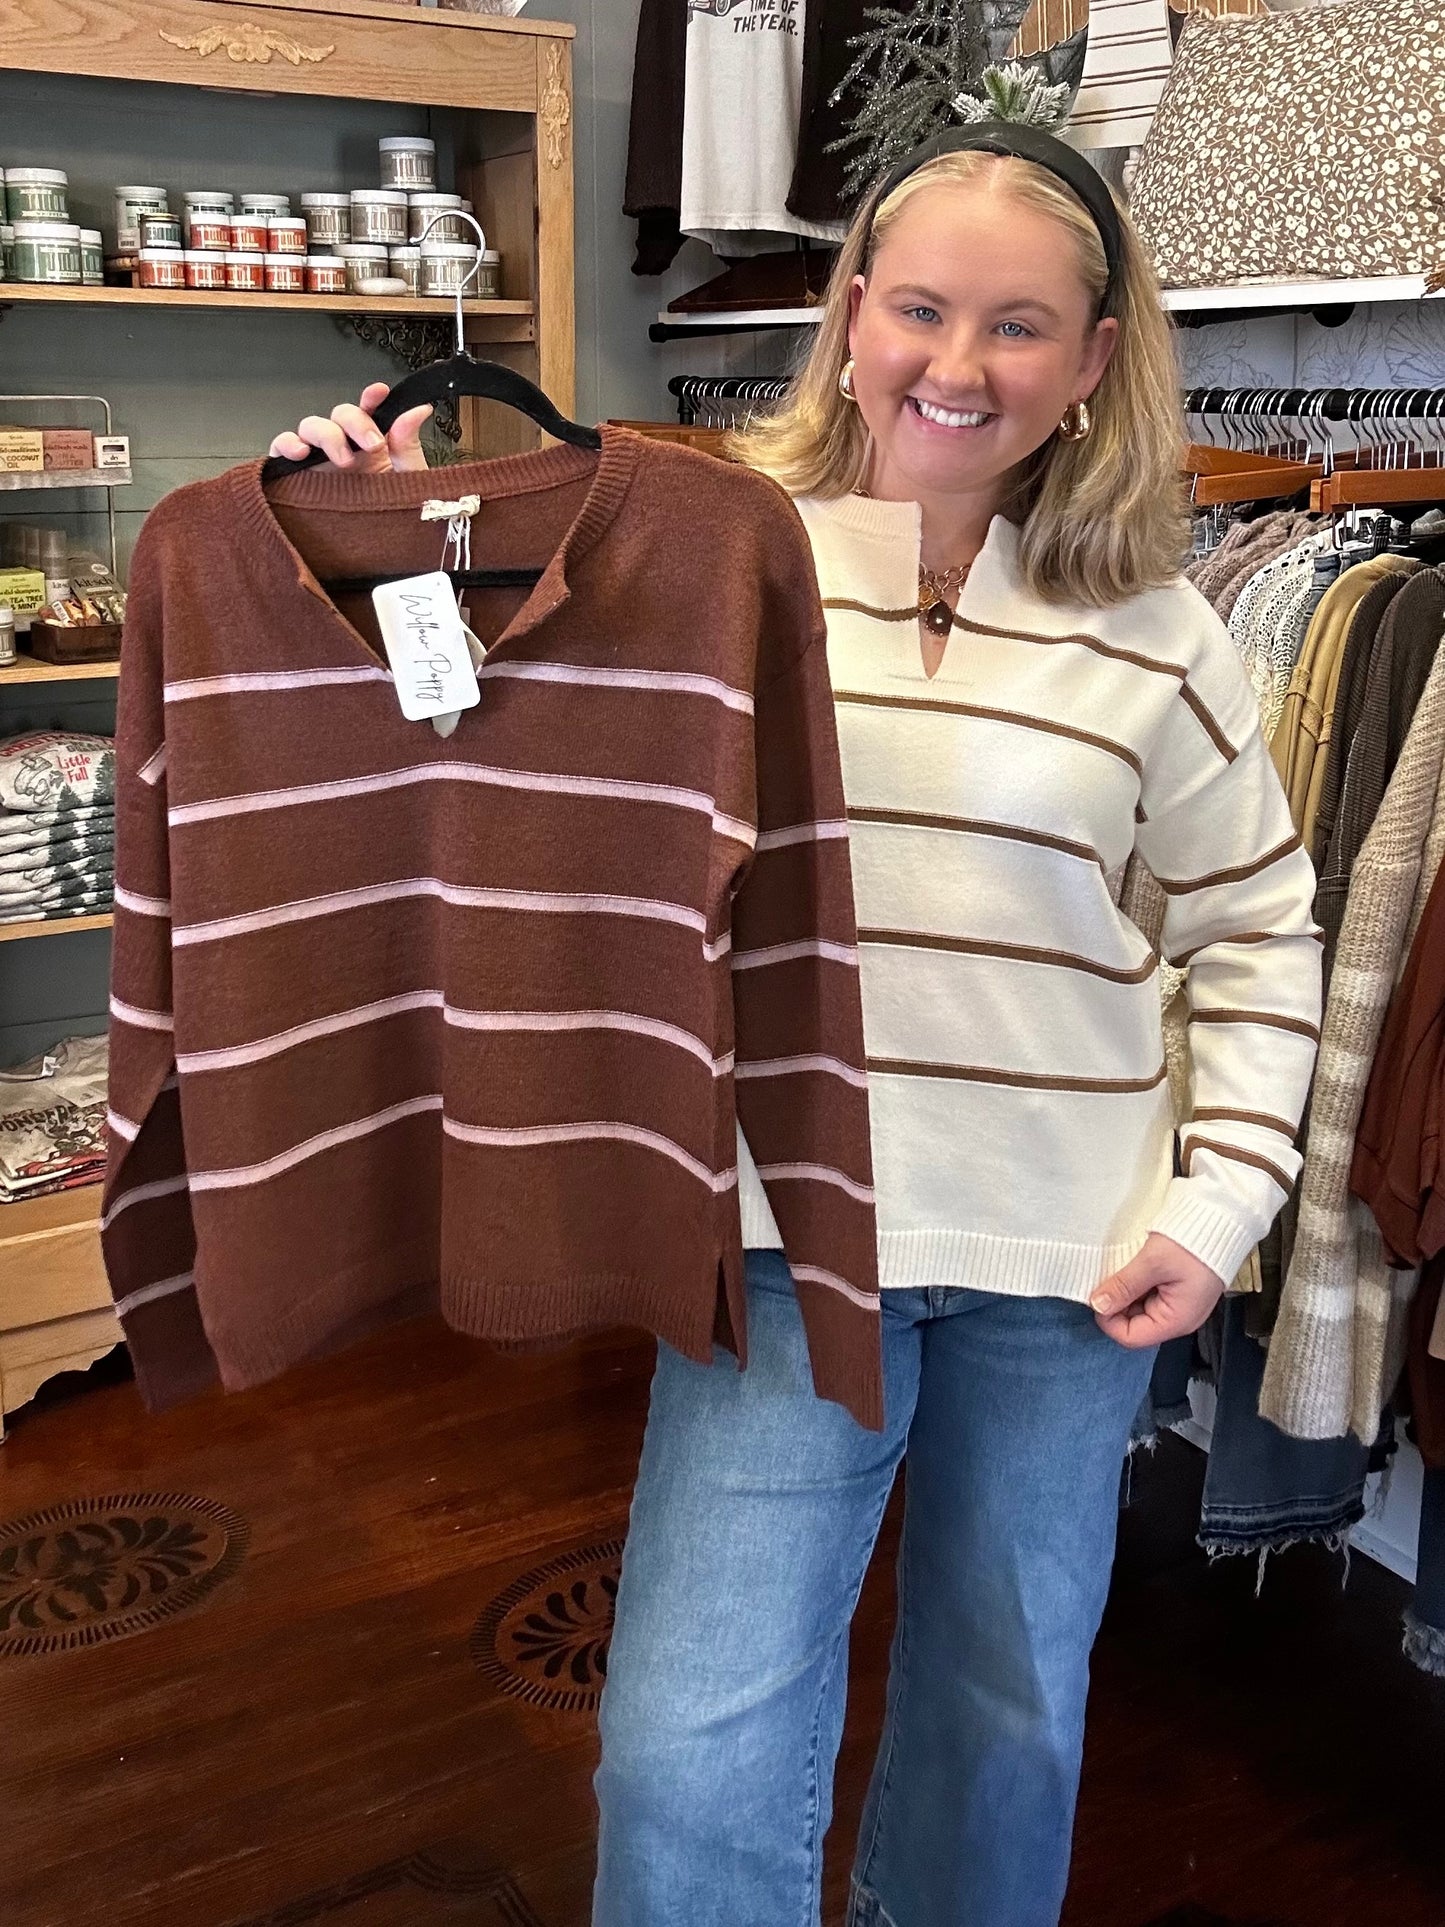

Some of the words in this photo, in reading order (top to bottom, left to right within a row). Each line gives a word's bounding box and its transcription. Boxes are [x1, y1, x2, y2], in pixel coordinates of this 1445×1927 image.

[750, 0, 776, 12] TIME
[781, 0, 799, 14] OF
[733, 15, 757, 33] THE
[760, 13, 798, 36] YEAR.
[399, 594, 440, 650] Willow
[413, 653, 453, 704] Poppy
[57, 754, 92, 770] Little
[67, 767, 89, 783] Full
